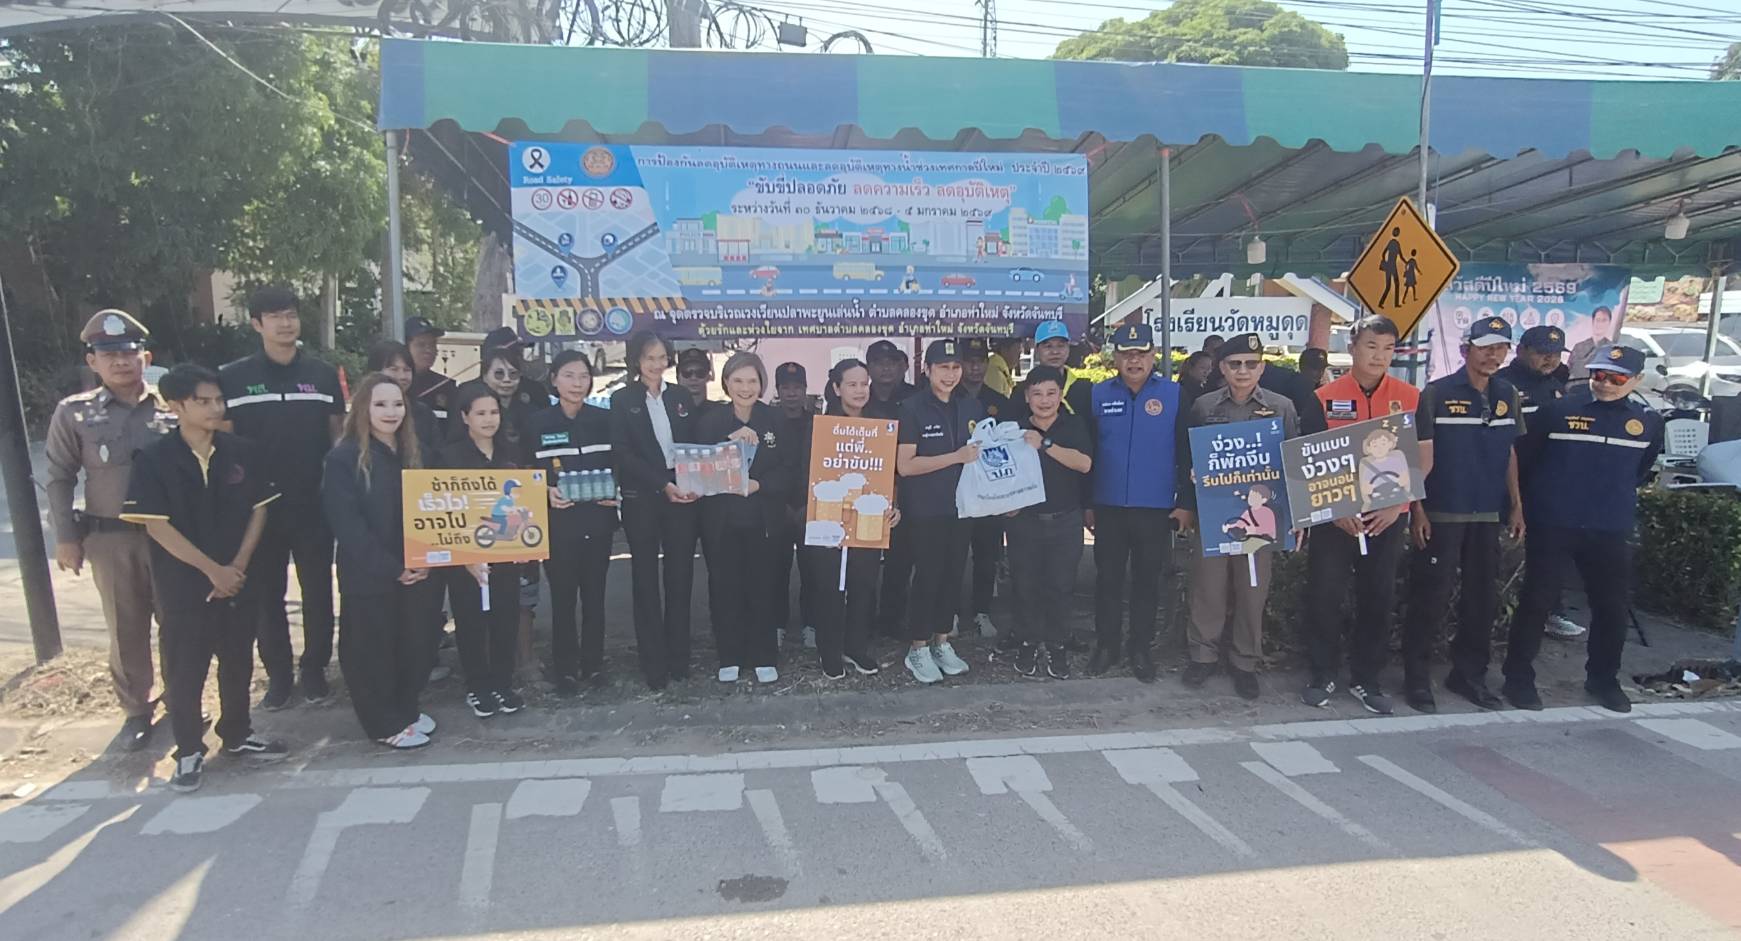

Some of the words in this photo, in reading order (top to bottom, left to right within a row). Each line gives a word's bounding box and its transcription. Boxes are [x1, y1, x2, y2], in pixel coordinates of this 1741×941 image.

[1011, 161, 1050, 173] ประจำปี
[523, 175, 543, 185] Road
[546, 175, 573, 185] Safety
[853, 177, 930, 197] ลดความเร็ว
[535, 193, 549, 204] 30
[731, 200, 791, 215] ระหว่างวันที่
[795, 206, 810, 215] ๓๐
[815, 202, 856, 215] ธันวาคม
[860, 206, 892, 215] ๒๕๖๘
[917, 206, 957, 216] มกราคม
[1450, 276, 1526, 293] วัสดีปีใหม่
[1532, 281, 1577, 294] 2569
[1455, 292, 1484, 302] HAPPY
[1487, 293, 1507, 303] NEW
[1510, 294, 1534, 304] YEAR
[1537, 295, 1564, 304] 2026
[654, 309, 667, 320] ณ
[869, 304, 936, 321] ตำบลคลองขุด
[939, 302, 999, 319] อำเภอท่าใหม่
[698, 320, 794, 338] ด้วยรักและห่วงใยจาก
[798, 322, 894, 337] เทศบาลตำบลคลองขุด
[898, 320, 953, 336] อำเภอท่าใหม่
[957, 322, 1014, 337] จังหวัดจันทบุรี
[836, 438, 872, 454] แต่พี่..
[1212, 432, 1262, 452] ง่วง..!
[1301, 436, 1350, 457] ขับแบบ
[823, 453, 883, 471] อย่าขับ!!!
[1208, 449, 1270, 471] ก็พักงีบ
[1301, 453, 1356, 479] ง่วงๆ
[431, 476, 497, 492] ช้าก็ถึงได้
[1202, 465, 1280, 488] รีบไปก็เท่านั้น
[1308, 473, 1354, 492] อาจนอน
[418, 492, 469, 512] เร็วไว!
[1311, 484, 1357, 507] ยาวๆ
[414, 512, 467, 530] อาจไป
